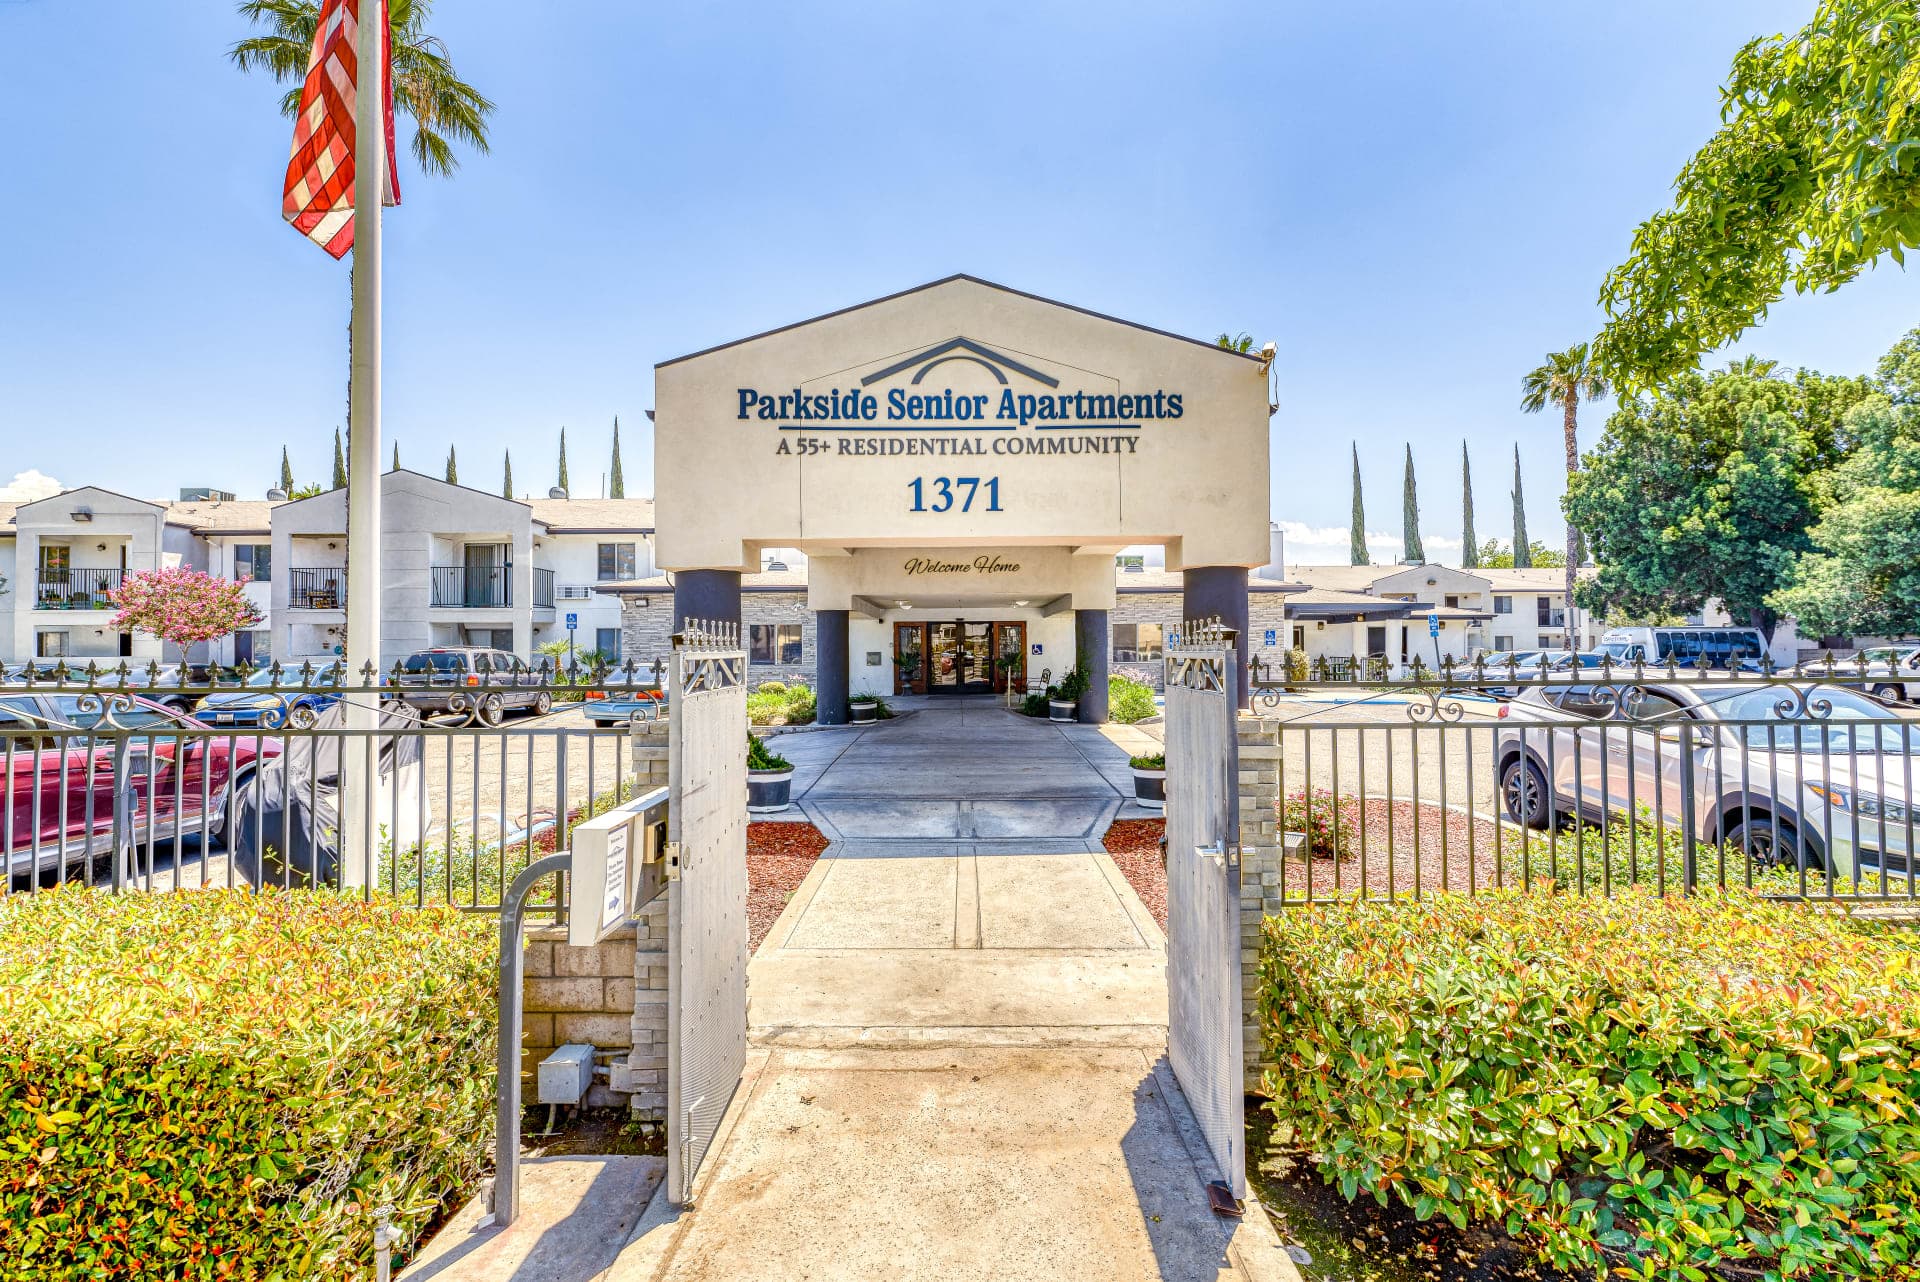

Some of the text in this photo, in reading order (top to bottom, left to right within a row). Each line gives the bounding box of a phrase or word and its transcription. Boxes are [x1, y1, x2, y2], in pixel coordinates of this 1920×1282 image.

[737, 388, 1184, 426] Parkside Senior Apartments
[776, 436, 1140, 456] A 55+ RESIDENTIAL COMMUNITY
[907, 476, 1004, 513] 1371
[904, 555, 1021, 575] Welcome Home
